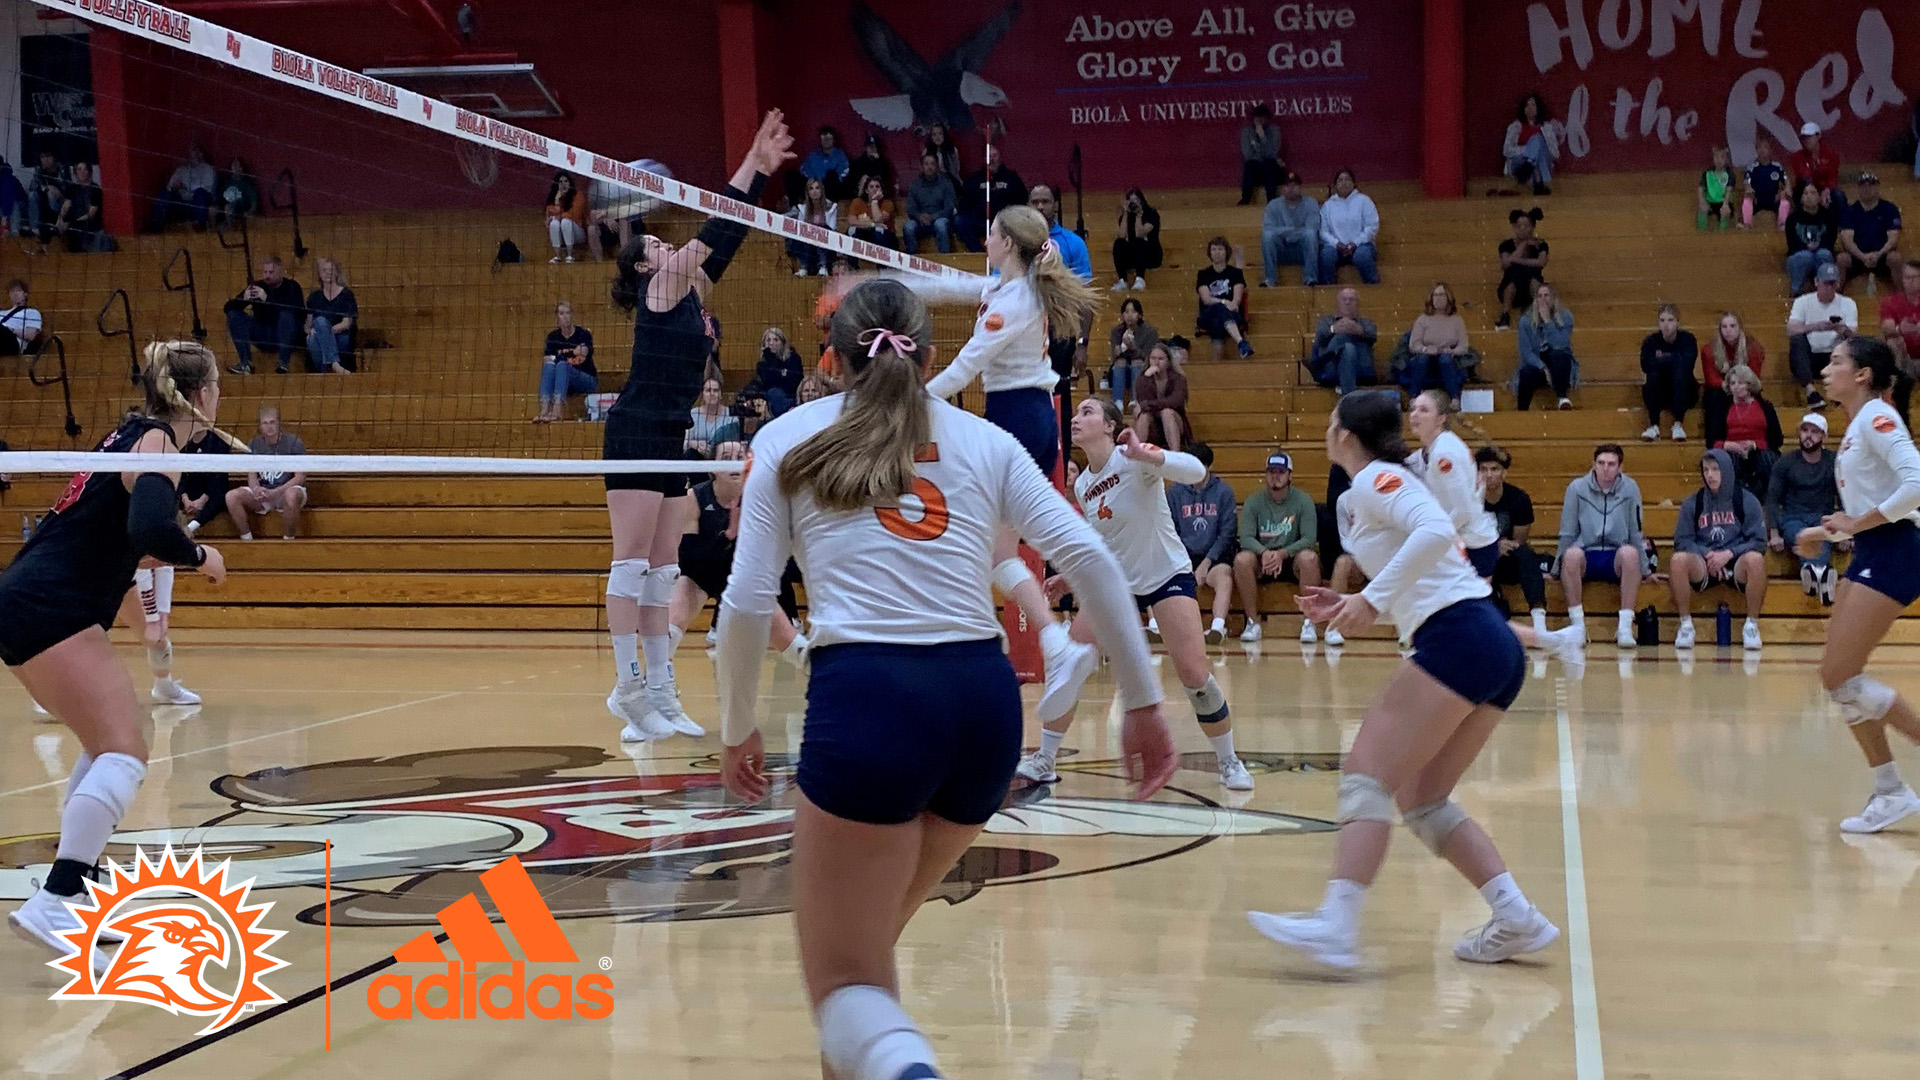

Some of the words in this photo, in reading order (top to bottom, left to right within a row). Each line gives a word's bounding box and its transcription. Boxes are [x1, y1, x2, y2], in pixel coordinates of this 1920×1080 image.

[226, 31, 242, 60] BU
[1065, 15, 1174, 42] Above
[1274, 3, 1356, 31] Give
[1527, 0, 1768, 73] HOME
[272, 48, 314, 83] BIOLA
[317, 64, 398, 109] VOLLEYBALL
[1077, 52, 1181, 84] Glory
[1200, 46, 1247, 73] To
[1268, 40, 1344, 70] God
[1070, 106, 1130, 125] BIOLA
[1274, 96, 1353, 117] EAGLES
[1611, 77, 1699, 145] the
[1726, 8, 1908, 167] Red
[455, 108, 487, 138] BIOLA
[488, 119, 549, 158] VOLLEYBALL
[874, 442, 949, 541] 5
[1098, 495, 1113, 520] 4
